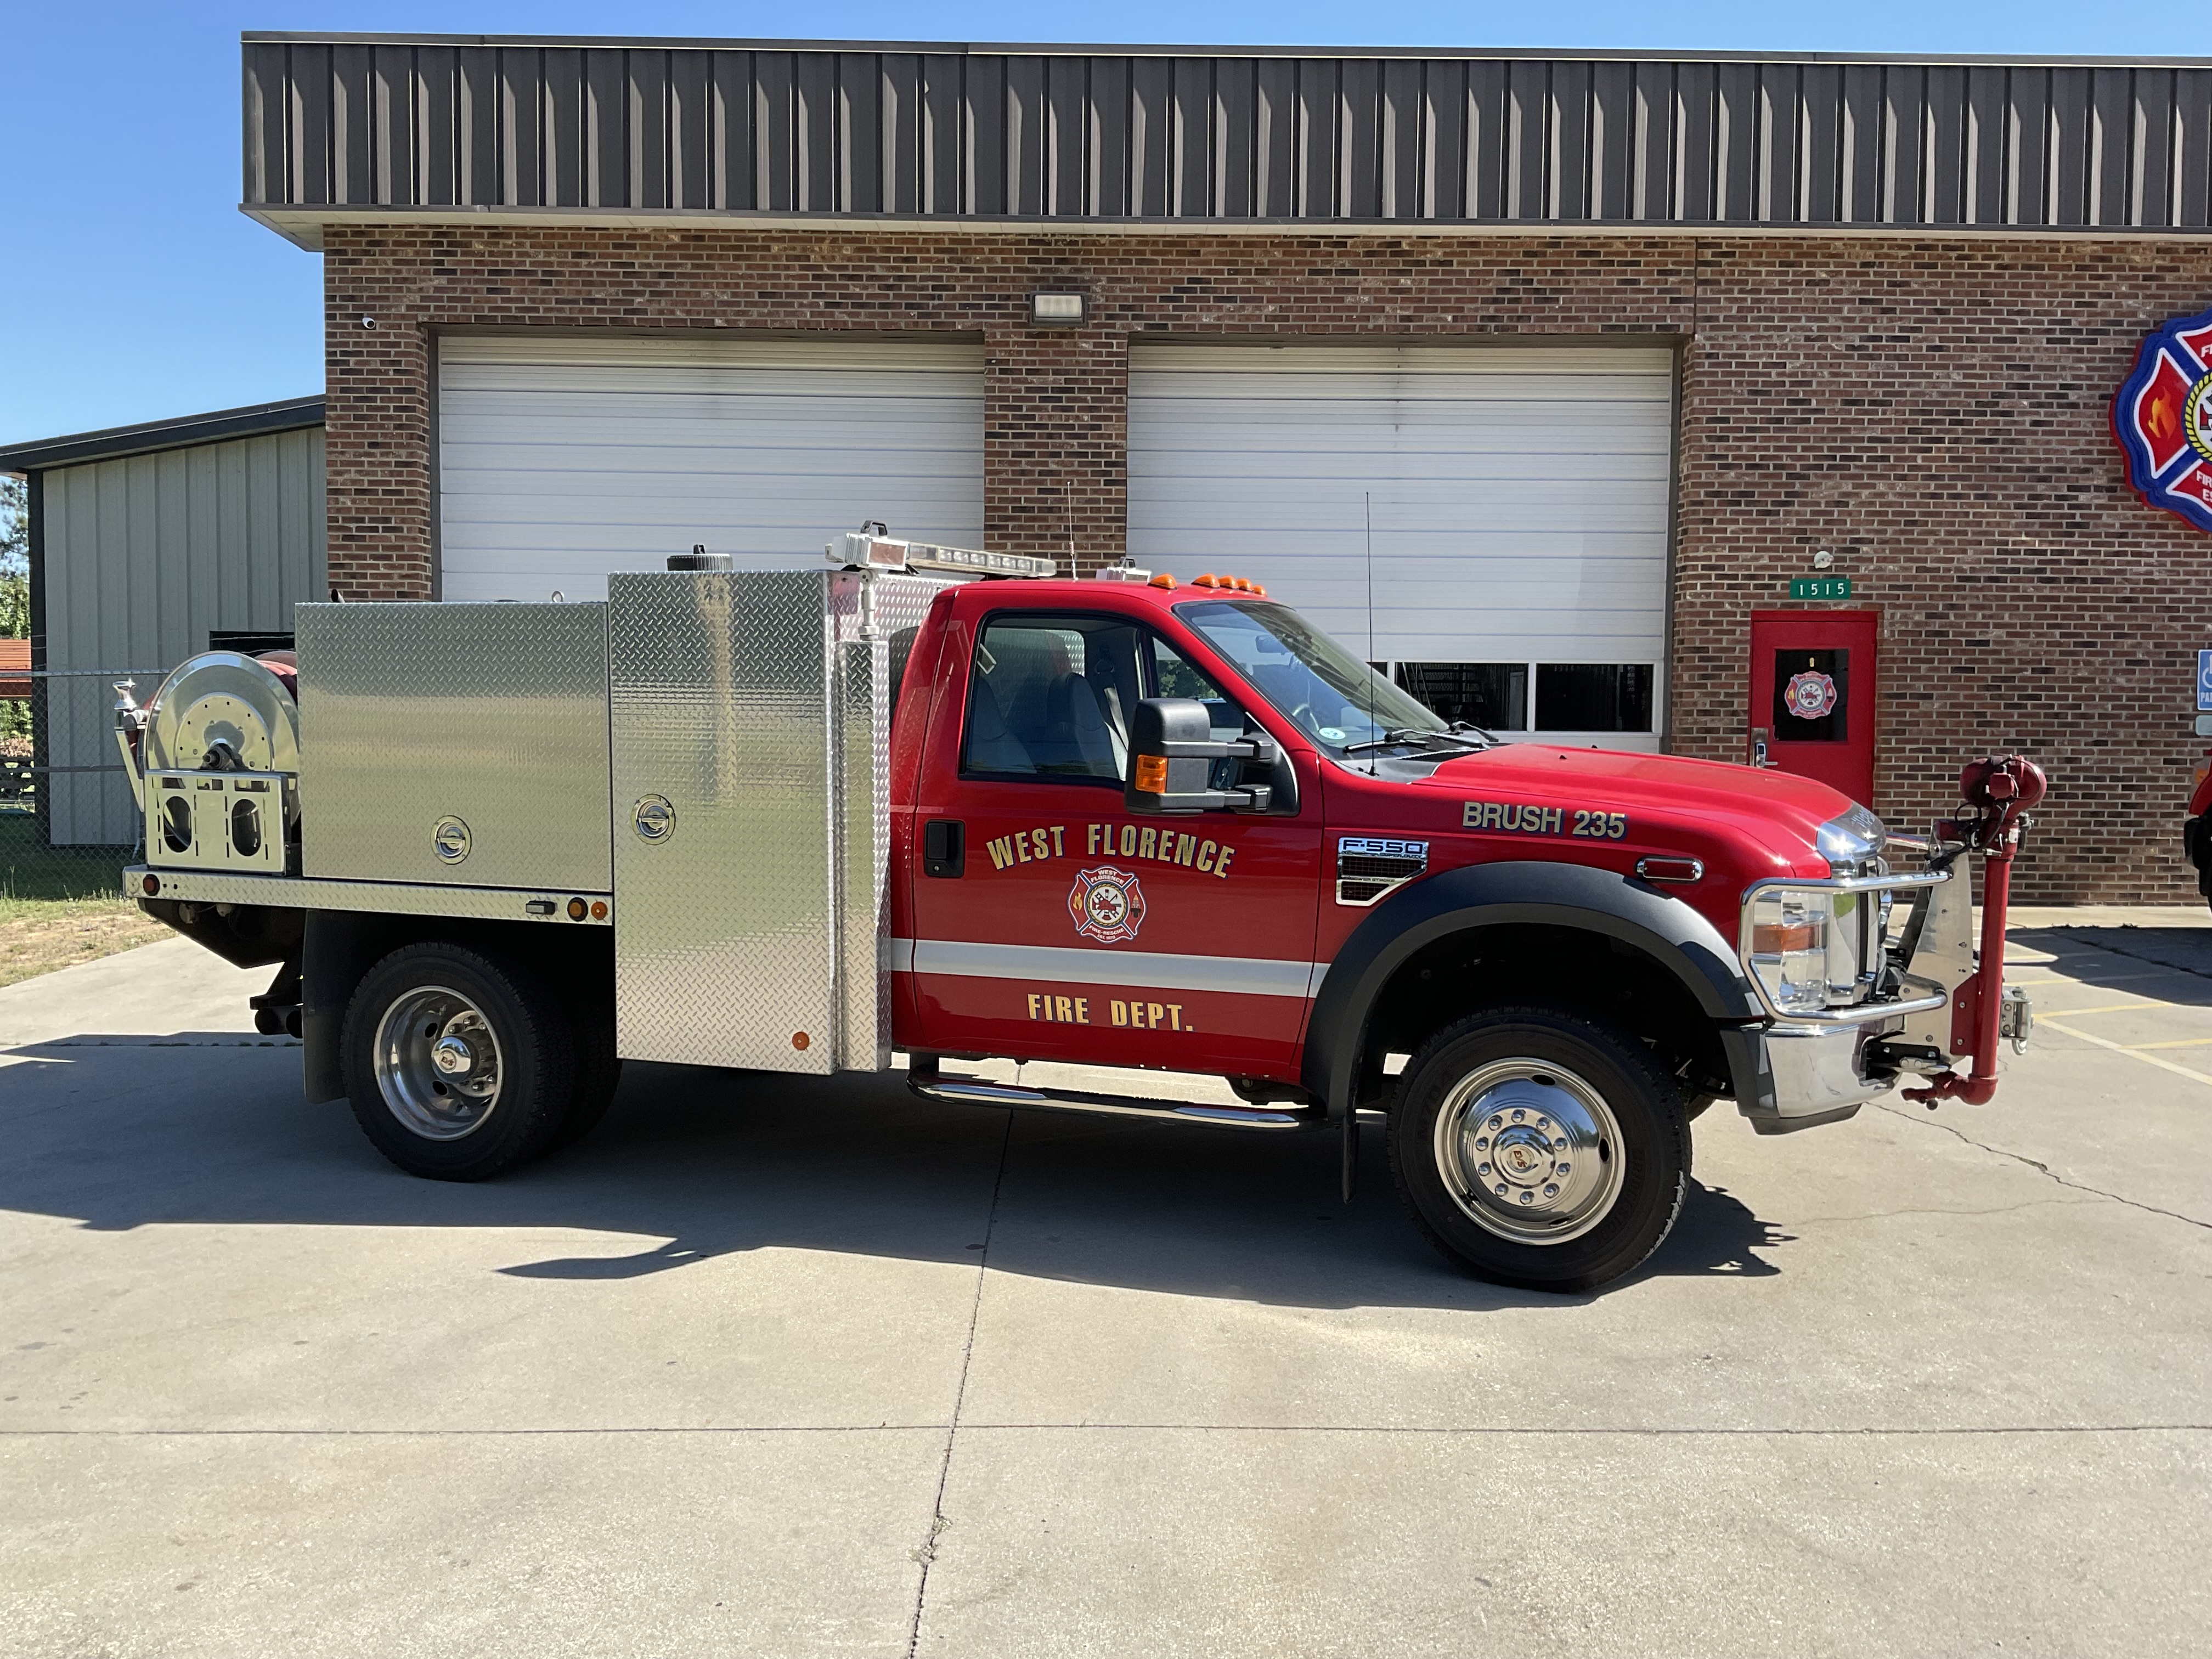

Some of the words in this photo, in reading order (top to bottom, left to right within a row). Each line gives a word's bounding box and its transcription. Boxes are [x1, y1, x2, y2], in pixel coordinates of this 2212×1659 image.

[1799, 583, 1844, 596] 1515
[1463, 801, 1562, 833] BRUSH
[1572, 810, 1626, 839] 235
[986, 826, 1065, 871] WEST
[1088, 824, 1235, 878] FLORENCE
[1343, 839, 1423, 854] F-550
[1090, 874, 1125, 885] FLORENCE
[1028, 994, 1090, 1024] FIRE
[1110, 1000, 1194, 1032] DEPT.
